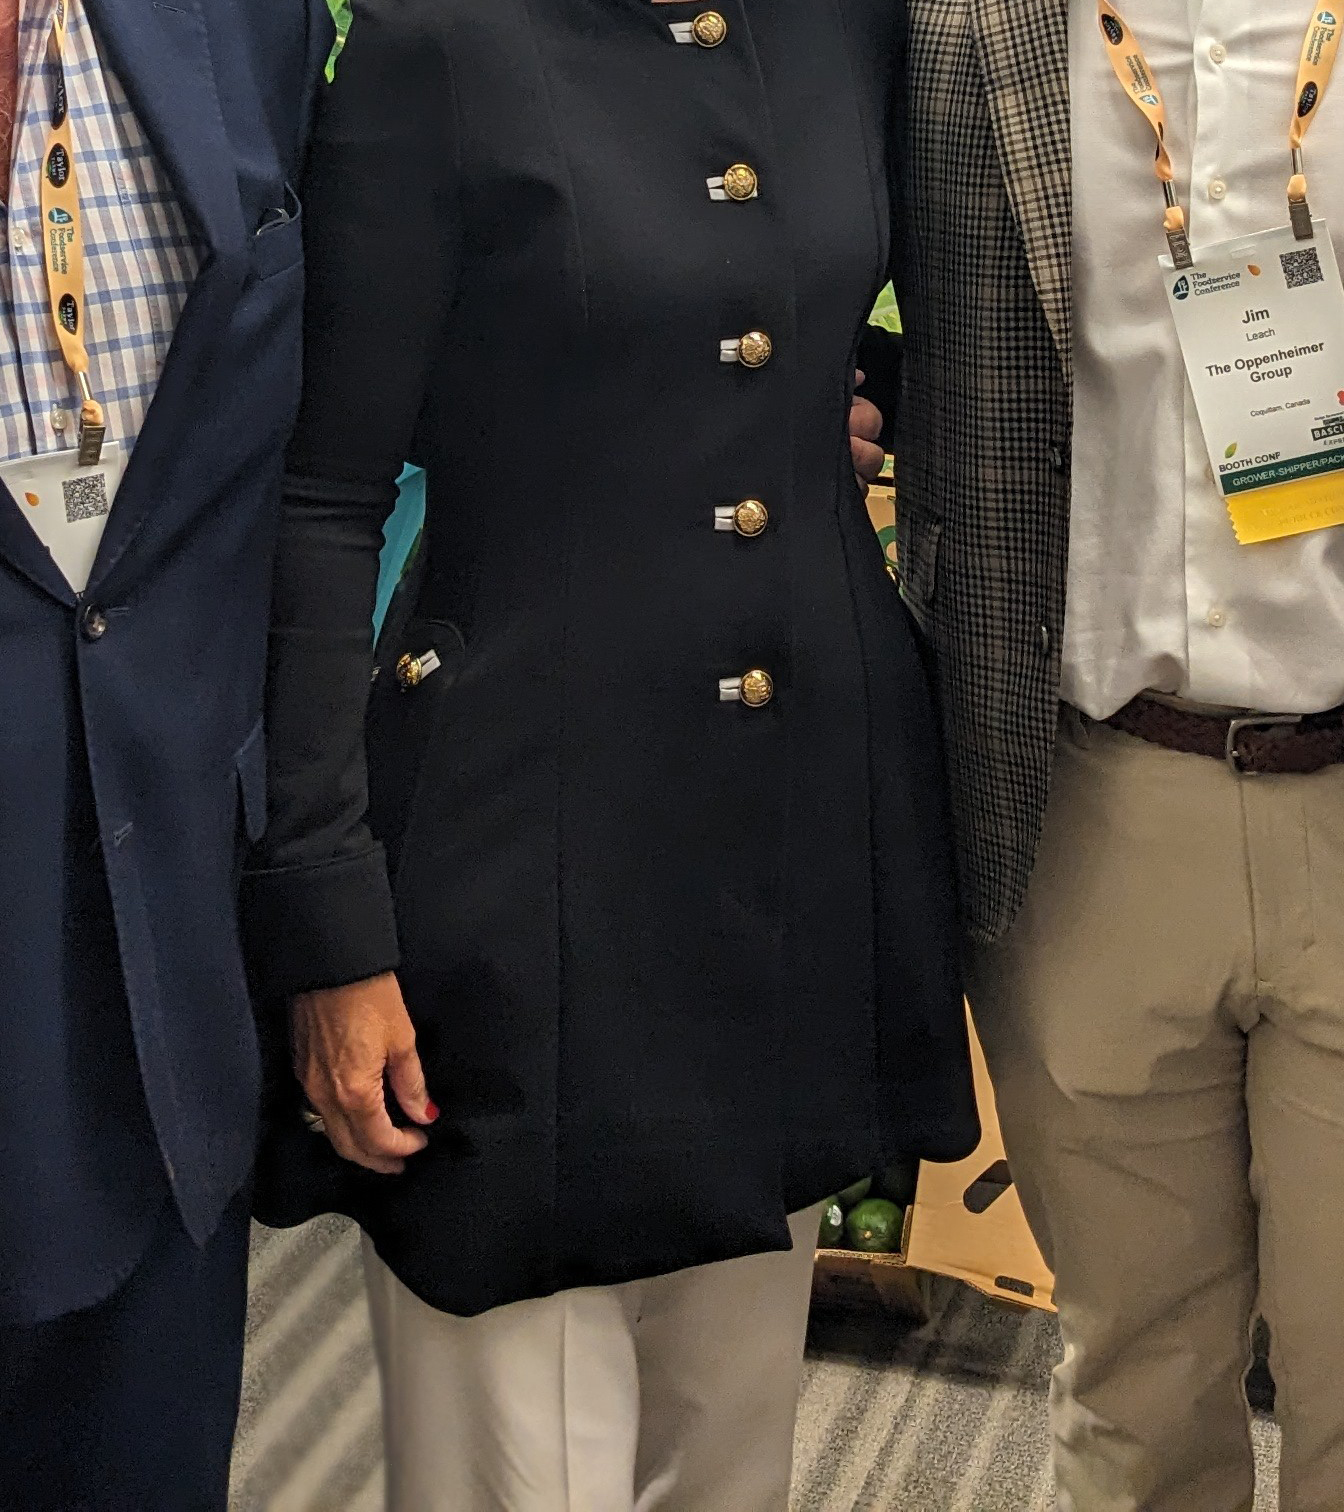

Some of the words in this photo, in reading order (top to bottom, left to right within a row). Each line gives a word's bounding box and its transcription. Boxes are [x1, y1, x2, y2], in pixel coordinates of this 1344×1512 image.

[56, 147, 66, 181] Taylor
[1190, 272, 1206, 281] The
[1193, 272, 1240, 288] Foodservice
[1195, 280, 1240, 296] Conference
[1242, 308, 1270, 324] Jim
[1246, 328, 1276, 342] Leach
[1206, 364, 1231, 377] The
[1234, 342, 1324, 370] Oppenheimer
[1250, 366, 1293, 383] Group
[1285, 398, 1311, 409] Canada
[1218, 459, 1253, 473] BOOTH
[1255, 451, 1281, 464] CONF
